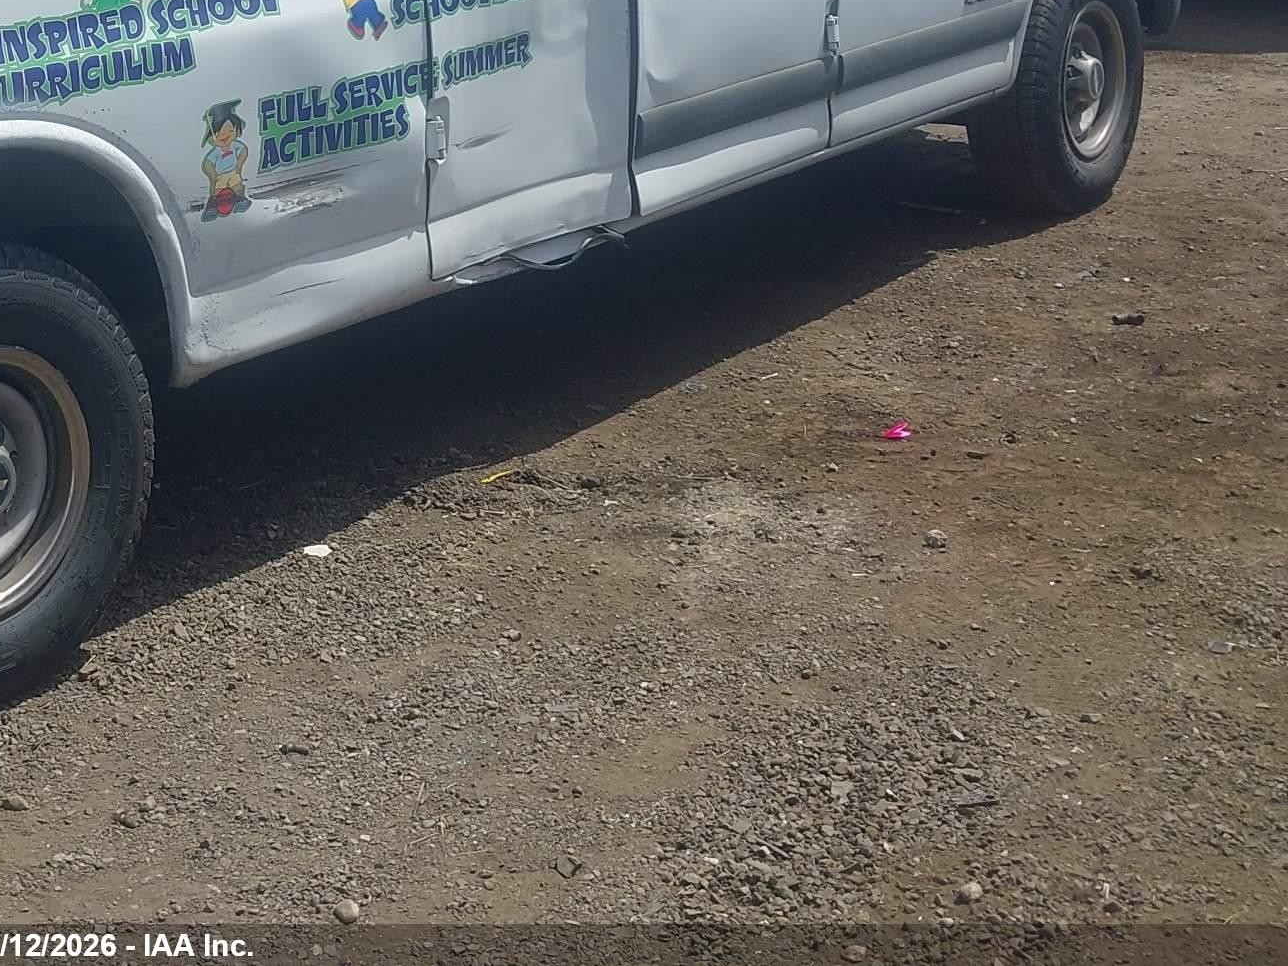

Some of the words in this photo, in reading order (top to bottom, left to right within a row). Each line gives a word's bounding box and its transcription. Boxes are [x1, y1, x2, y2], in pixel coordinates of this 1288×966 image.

[258, 91, 329, 133] FULL
[332, 59, 439, 115] SERVICE
[442, 34, 533, 89] SUMMER
[259, 103, 410, 170] ACTIVITIES
